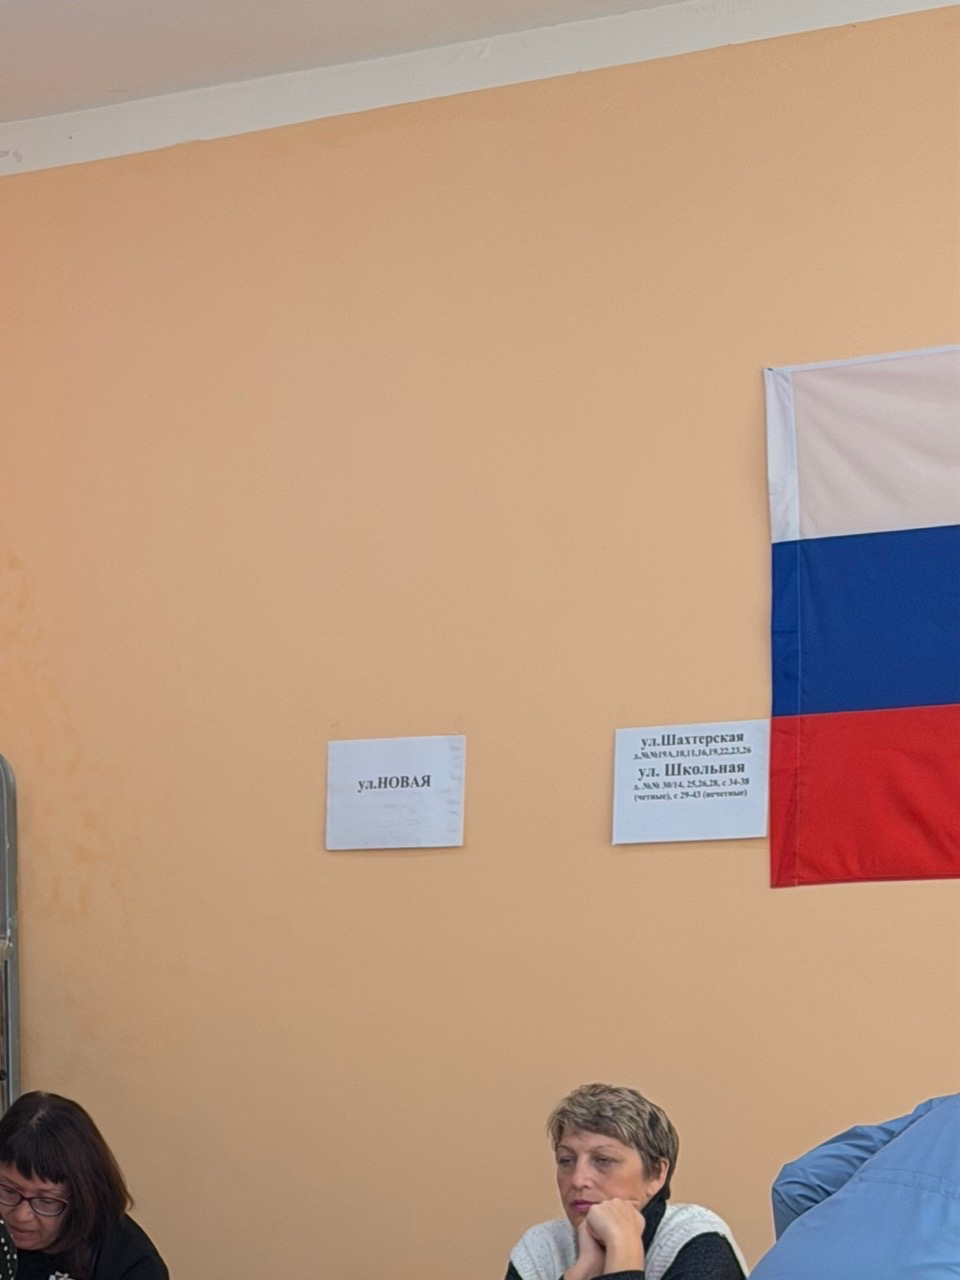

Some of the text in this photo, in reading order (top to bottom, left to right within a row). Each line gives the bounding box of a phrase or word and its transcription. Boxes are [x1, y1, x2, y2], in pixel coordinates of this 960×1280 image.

[640, 733, 745, 751] ул.Шахтерская
[637, 763, 746, 781] ул. Школьная
[357, 774, 432, 793] ул.НОВАЯ
